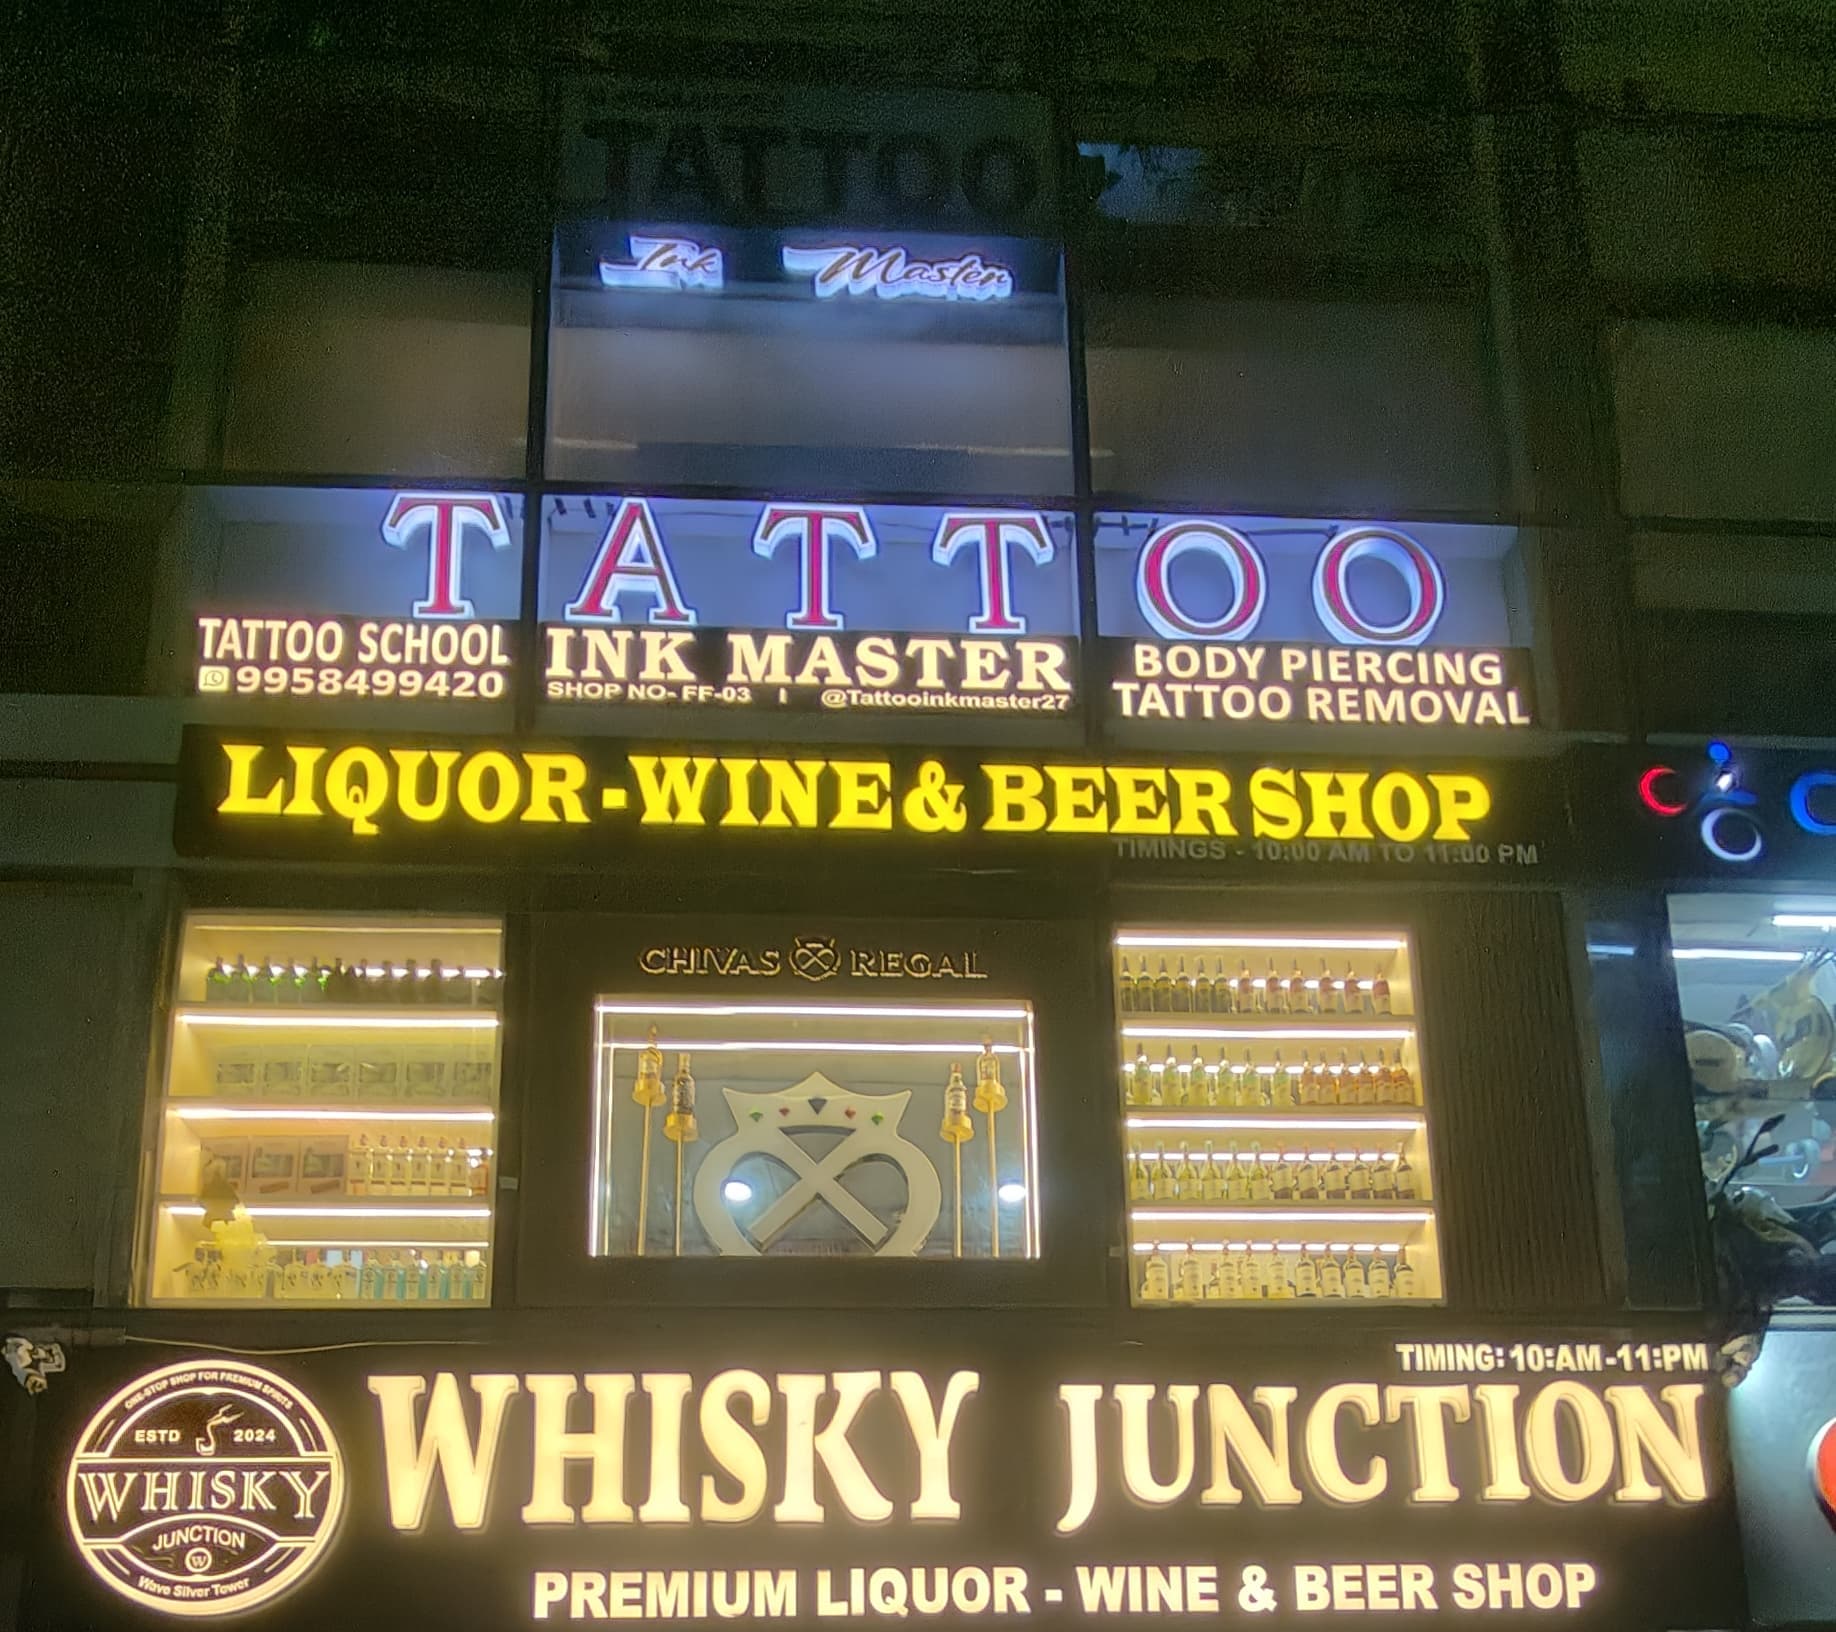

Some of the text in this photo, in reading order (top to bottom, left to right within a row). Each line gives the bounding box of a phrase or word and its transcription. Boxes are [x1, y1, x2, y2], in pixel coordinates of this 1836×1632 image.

[582, 119, 1039, 215] TATTOO
[600, 236, 1013, 300] Ink Master
[382, 490, 1445, 645] TATTOO
[198, 618, 511, 665] TATTOO SCHOOL
[546, 627, 1071, 690] INK MASTER
[236, 666, 504, 698] 9958499420
[1134, 643, 1502, 686] BODY PIERCING
[547, 682, 621, 699] SHOP
[682, 686, 751, 703] FF-03
[821, 688, 1069, 711] @Tattooinkmaster27
[1112, 682, 1531, 725] TATTOO REMOVAL
[904, 760, 967, 832] &
[981, 764, 1239, 839] BEER
[1251, 767, 1491, 841] SHOP
[1114, 838, 1226, 861] TIMINGS
[1254, 841, 1320, 863] 10:00
[1328, 842, 1374, 863] AM
[1379, 842, 1415, 864] TO
[1426, 843, 1490, 865] 11:00
[1500, 844, 1538, 865] PM
[640, 947, 988, 979] CHIVAS REGAL
[169, 1372, 197, 1386] SHOP
[198, 1371, 218, 1381] FOR
[219, 1372, 263, 1390] PREMIUM
[135, 1429, 181, 1443] ESTD
[233, 1429, 277, 1443] 2024
[368, 1369, 1707, 1534] WHISKY JUNCTION
[78, 1470, 330, 1522] WHISKY
[152, 1525, 246, 1551] JUNCTION
[138, 1575, 250, 1598] Wave Silver Tower
[533, 1571, 797, 1619] PREMIUM
[817, 1567, 1031, 1618] LIQUOR
[1076, 1565, 1220, 1613] WINE
[1238, 1564, 1279, 1613] &
[1294, 1564, 1439, 1612] BEER
[1452, 1561, 1597, 1610] SHOP
